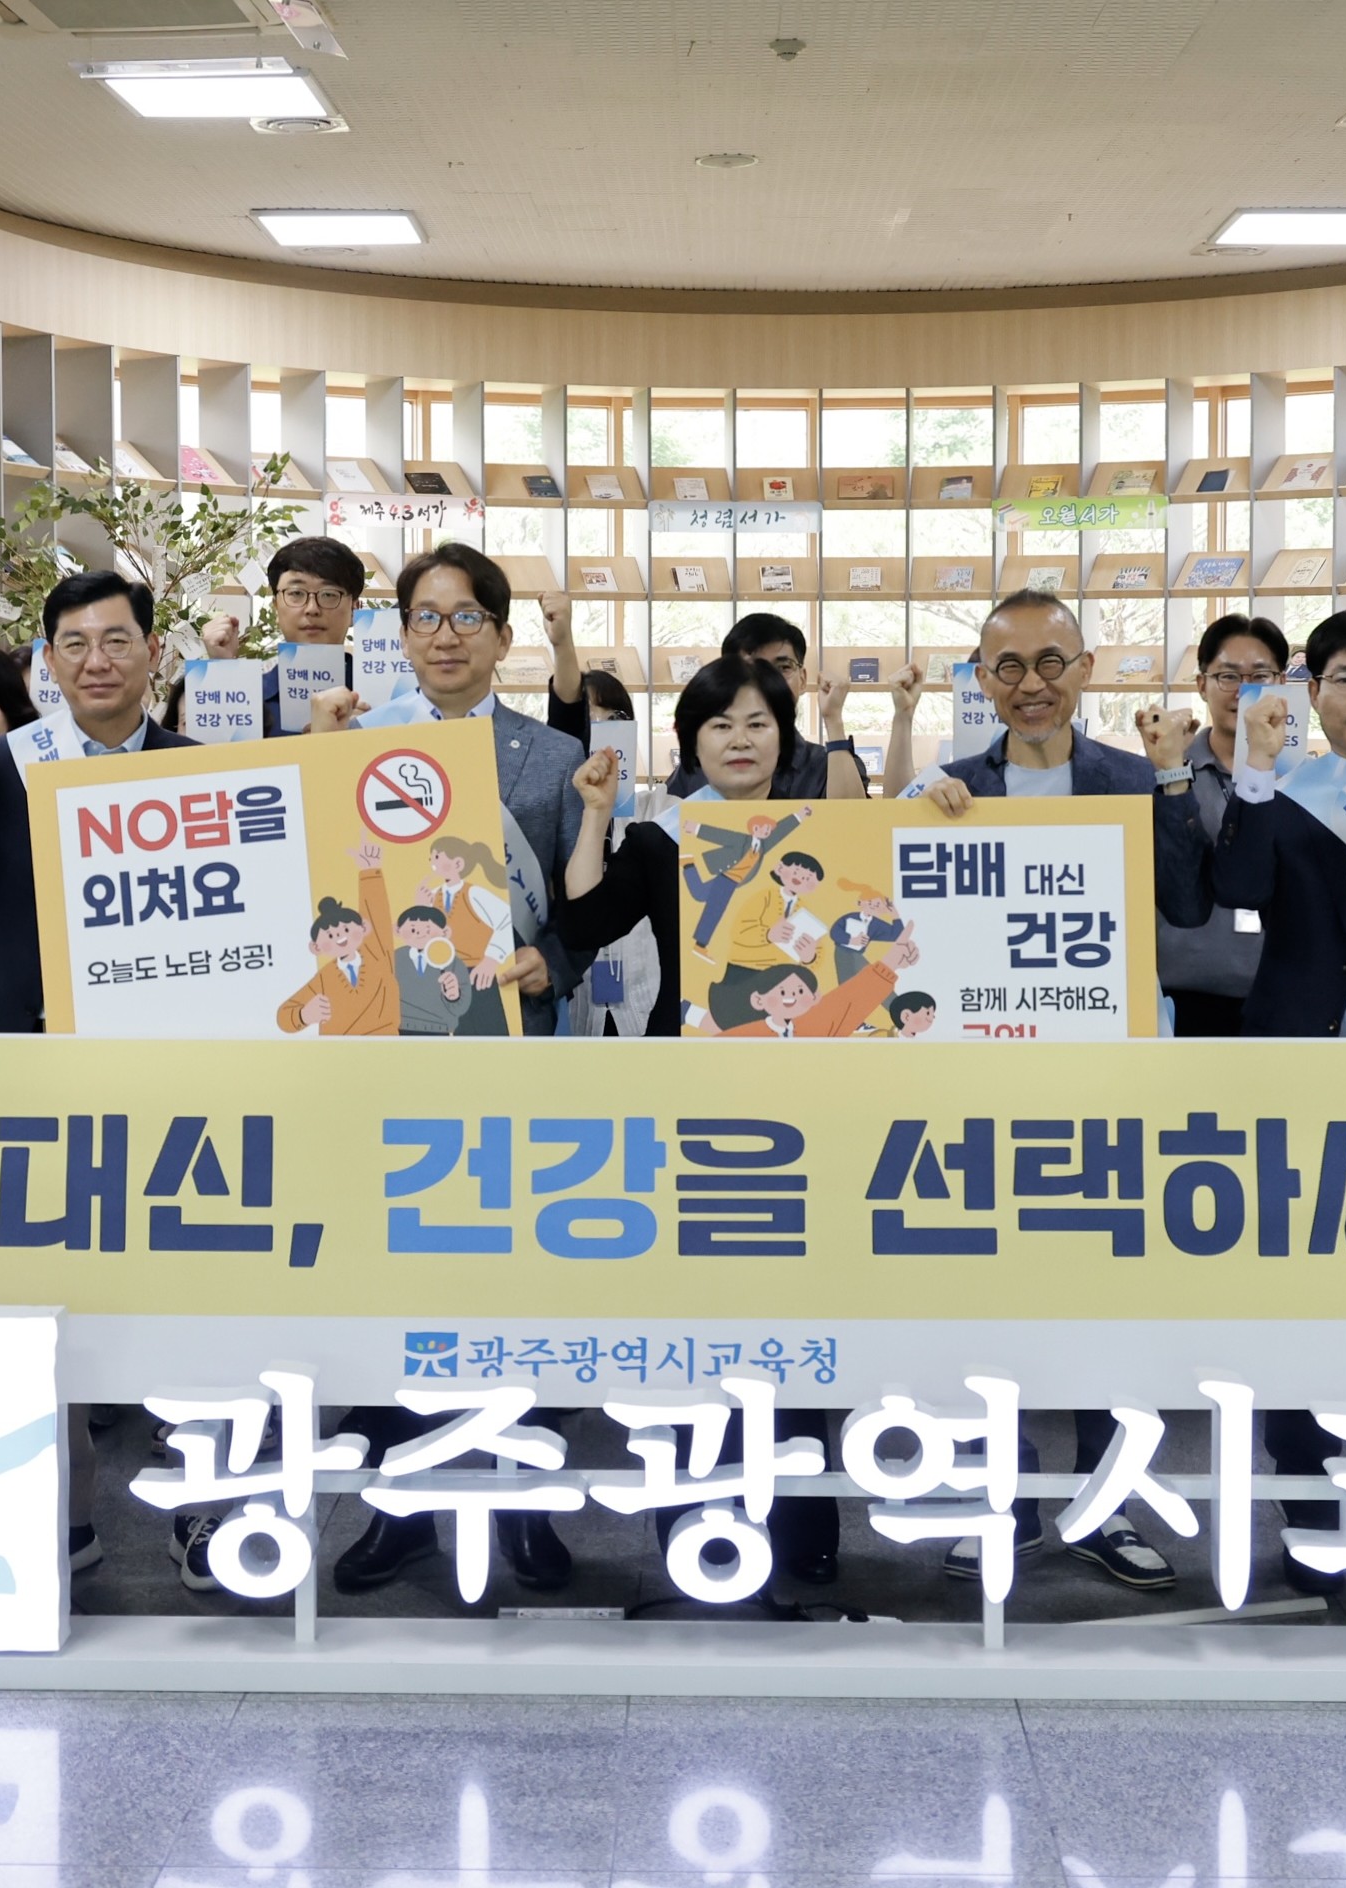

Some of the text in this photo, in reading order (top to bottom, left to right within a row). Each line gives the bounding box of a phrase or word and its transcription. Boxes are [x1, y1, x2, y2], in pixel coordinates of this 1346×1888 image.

[359, 500, 447, 528] 제주 4.3 서가
[361, 639, 386, 652] 담배
[287, 668, 334, 683] 담배 NO,
[361, 661, 416, 674] 건강 YES
[38, 690, 62, 703] 건강
[195, 691, 250, 705] 담배 NO,
[287, 687, 309, 700] 건강
[961, 691, 985, 704] 담배
[195, 714, 253, 727] 건강 YES
[961, 711, 985, 725] 건강
[77, 785, 287, 858] NO담을
[899, 842, 1085, 899] 담배 대신
[82, 861, 245, 928] 외쳐요
[1006, 911, 1117, 969] 건강
[87, 944, 274, 986] 오늘도 노담 성공!
[960, 986, 1118, 1014] 함께 시작해요,
[382, 1115, 809, 1259] 건강을
[465, 1336, 838, 1385] 광주광역시교육청
